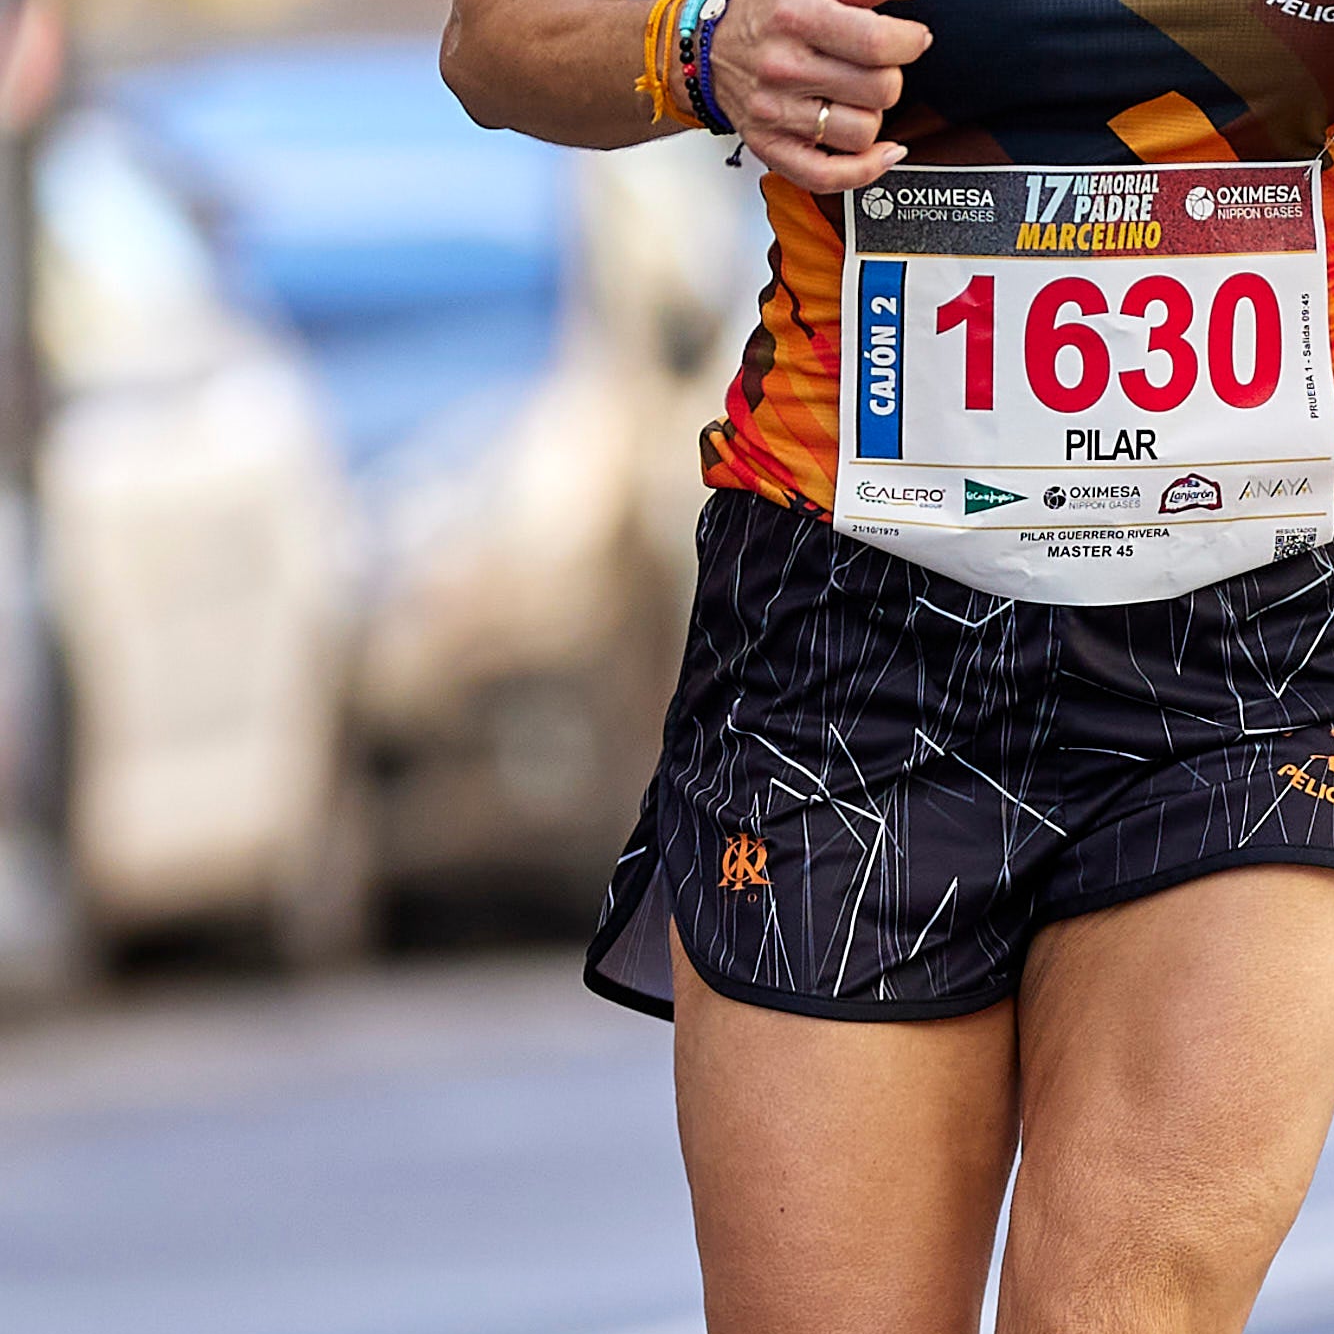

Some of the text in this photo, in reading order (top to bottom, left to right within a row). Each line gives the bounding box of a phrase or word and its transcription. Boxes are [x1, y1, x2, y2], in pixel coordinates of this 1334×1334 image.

[897, 188, 995, 207] OXIMESA
[1025, 174, 1159, 223] 17 MEMORIAL
[1216, 185, 1301, 204] OXIMESA
[897, 209, 995, 222] NIPPON GASES
[1073, 194, 1154, 223] PADRE
[1217, 206, 1303, 220] NIPPON GASES
[1015, 220, 1162, 251] MARCELINO
[1301, 293, 1310, 322] 09:45
[936, 272, 1283, 414] 1630
[1302, 324, 1312, 357] Salida
[864, 296, 897, 416] CAJÓN 2
[1305, 375, 1319, 419] PRUEBA
[1066, 429, 1158, 461] PILAR
[1069, 486, 1141, 499] OXIMESA
[1169, 488, 1214, 504] Lanjarón
[1239, 477, 1313, 500] ANAYA
[1069, 499, 1141, 510] NIPPON GASES
[852, 524, 900, 536] 21/10/1975
[1020, 528, 1170, 542] PILAR GUERRERO RIVERA
[1048, 545, 1134, 558] MASTER 45
